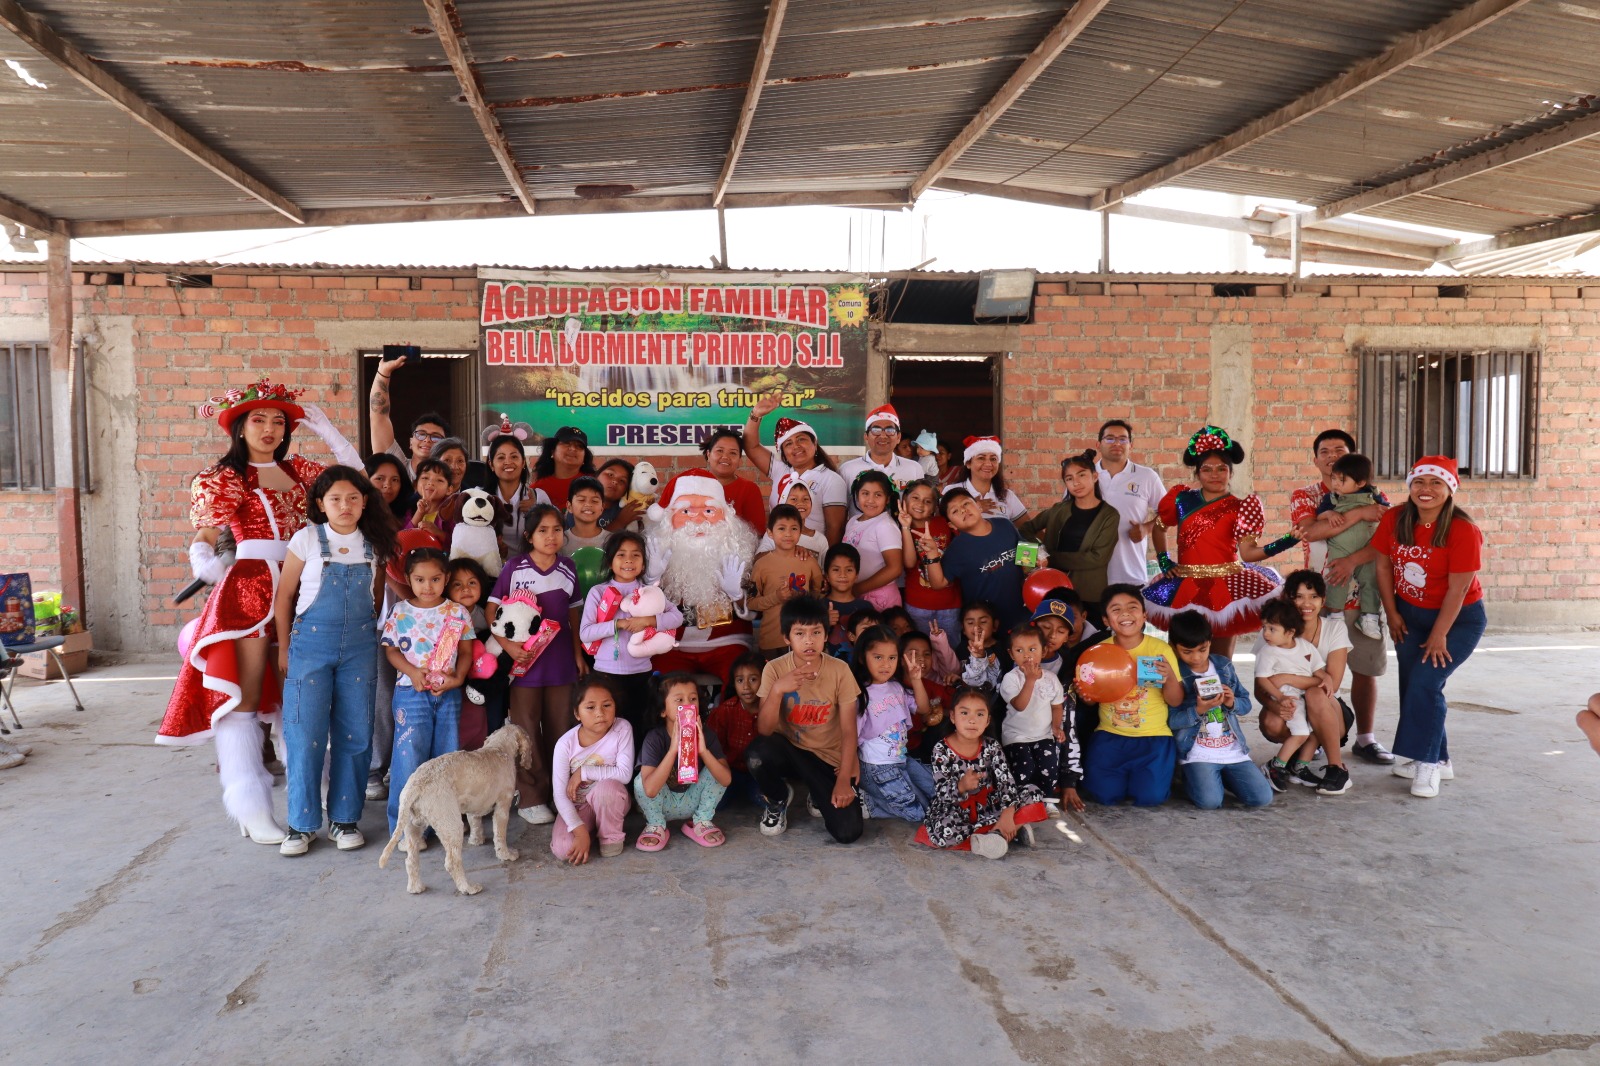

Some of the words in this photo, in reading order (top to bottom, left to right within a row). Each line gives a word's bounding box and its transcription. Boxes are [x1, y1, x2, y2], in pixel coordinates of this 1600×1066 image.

[482, 283, 683, 325] AGRUPACION
[688, 286, 829, 329] FAMILIAR
[838, 299, 862, 308] Comuna
[846, 311, 854, 319] 10
[486, 330, 555, 365] BELLA
[692, 332, 793, 368] PRIMERO
[658, 392, 711, 411] para
[607, 424, 744, 445] PRESEN
[787, 703, 832, 726] NIKE
